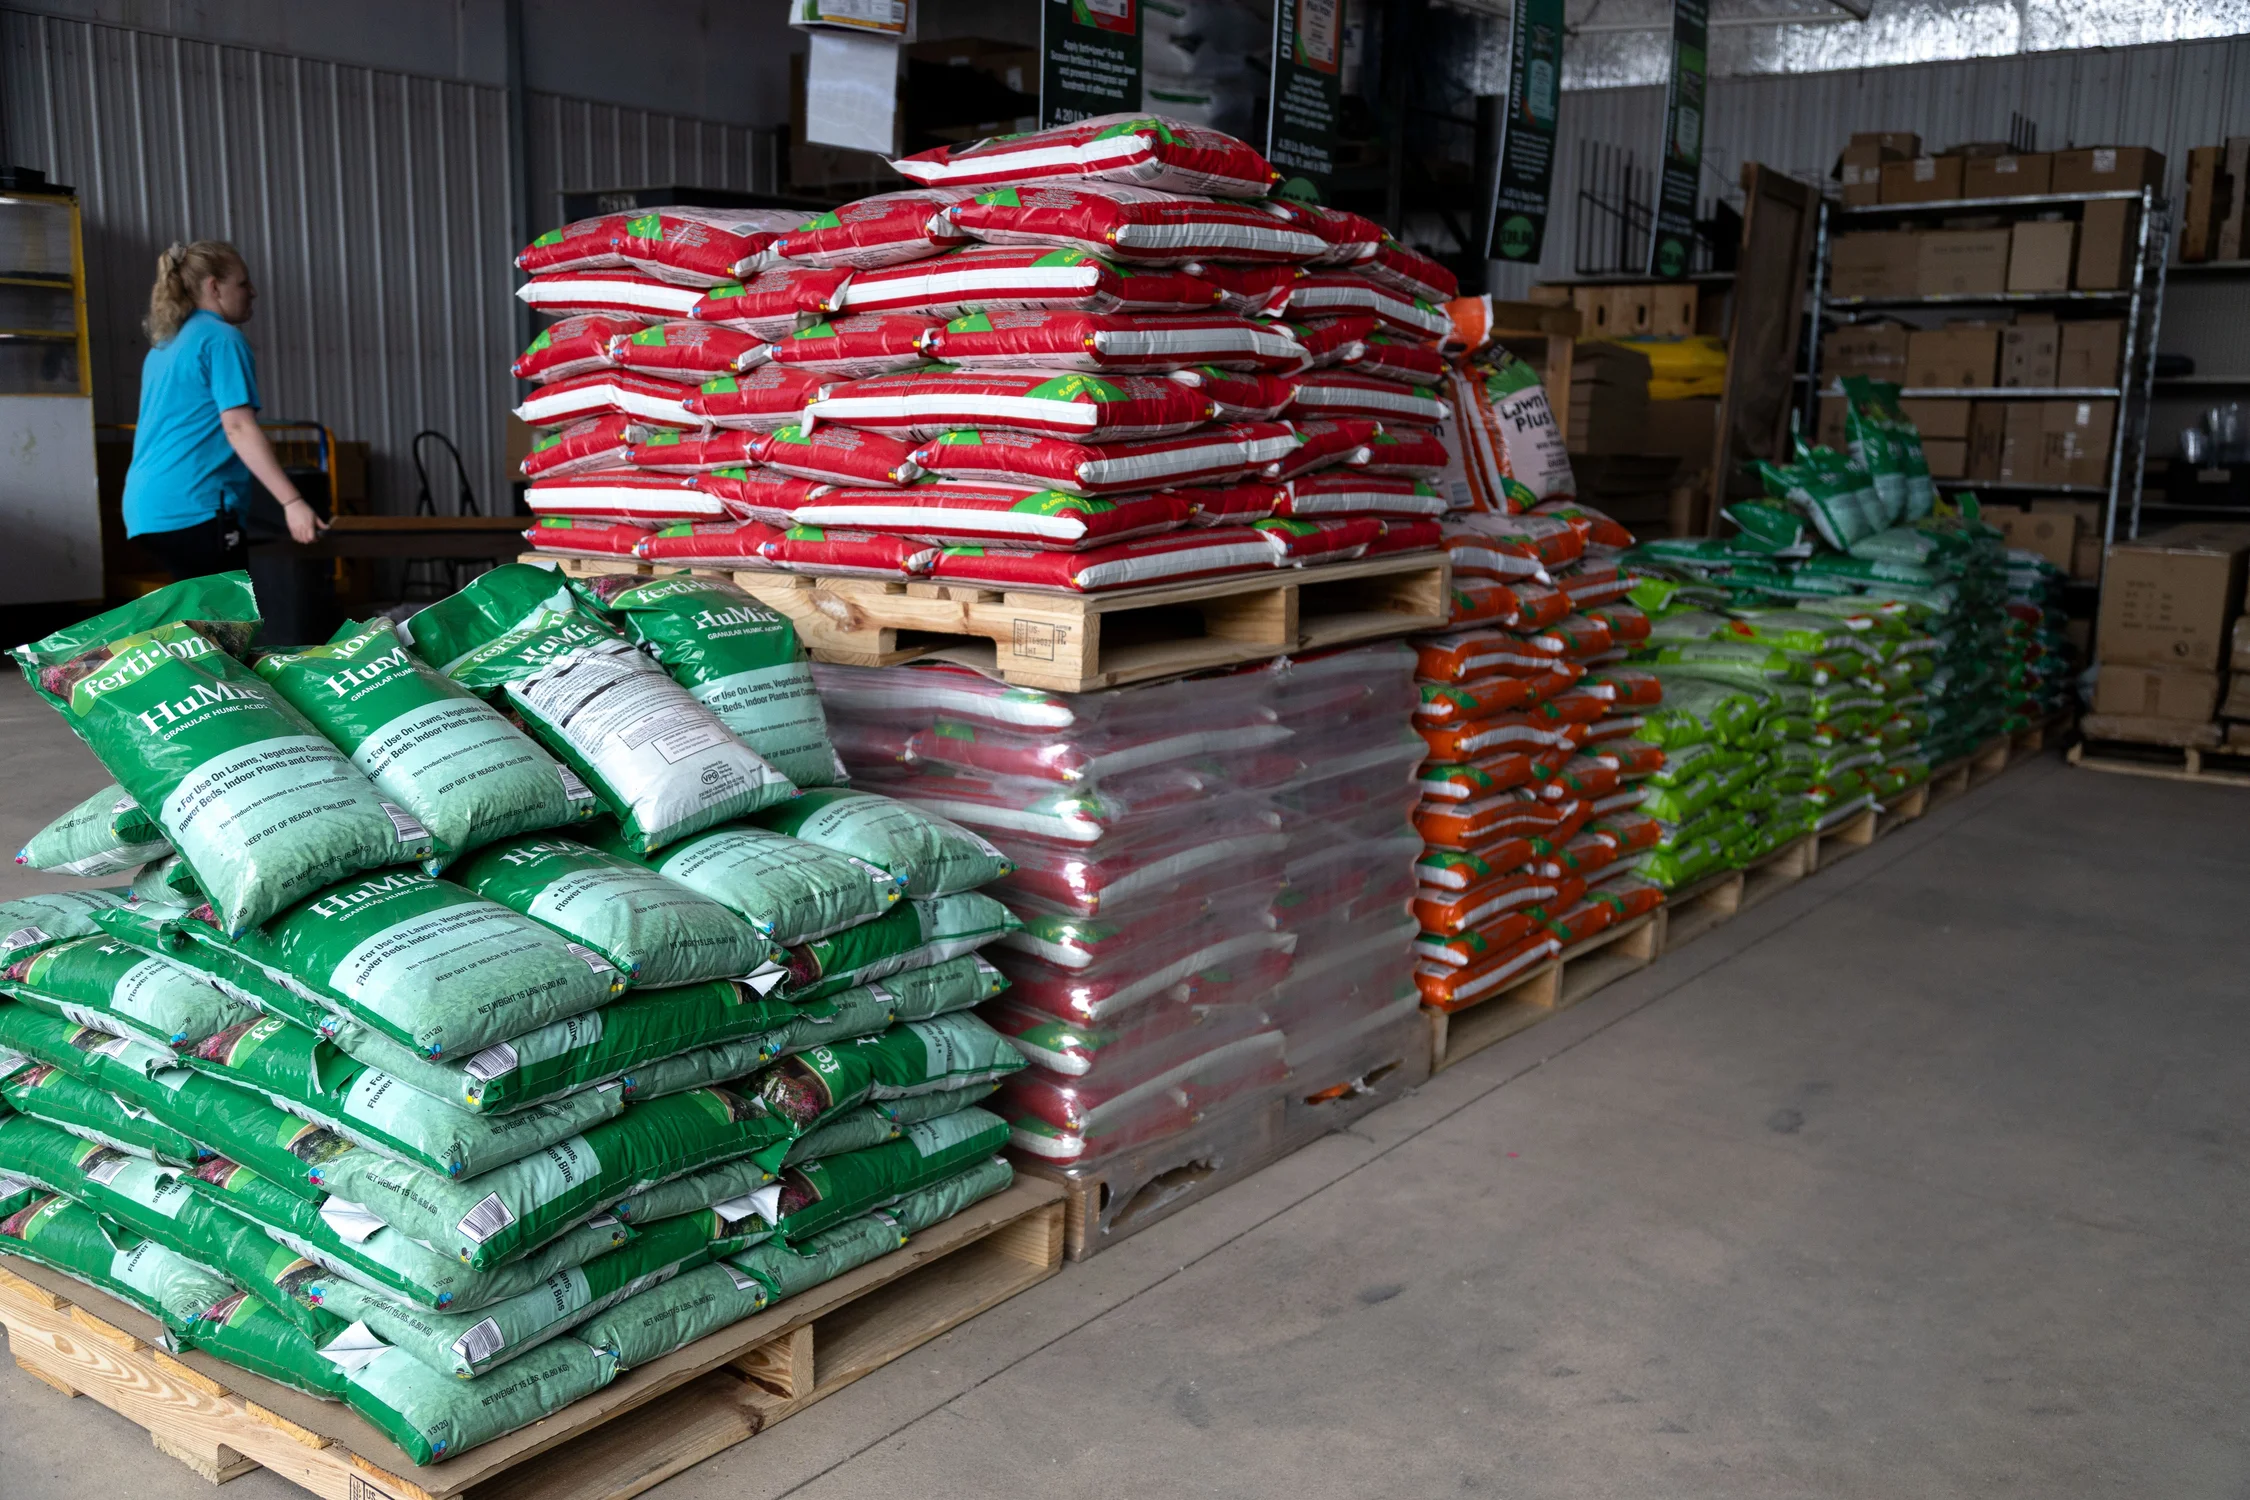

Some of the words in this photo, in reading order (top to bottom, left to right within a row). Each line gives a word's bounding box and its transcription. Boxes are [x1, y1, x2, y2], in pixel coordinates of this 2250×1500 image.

[1280, 0, 1294, 60] DEEP
[1515, 0, 1528, 69] LASTIN
[1510, 72, 1523, 120] LONG
[1515, 411, 1550, 433] Plus
[691, 606, 780, 630] HuMic
[707, 629, 743, 640] GRANULAR
[323, 646, 409, 699] HuM
[350, 675, 393, 702] GRANULAR
[721, 689, 737, 700] Use
[736, 686, 748, 696] On
[748, 681, 774, 693] Lawns,
[772, 677, 801, 688] Vegetable
[722, 700, 746, 714] Beds,
[745, 695, 768, 707] Indoor
[768, 690, 789, 701] Plants
[789, 690, 801, 698] and
[136, 681, 265, 736] HuMic
[163, 713, 212, 741] GRANULAR
[212, 704, 243, 717] HUMIC
[370, 744, 385, 759] For
[384, 732, 402, 748] Use
[401, 725, 415, 737] On
[414, 713, 446, 730] Lawns,
[442, 706, 480, 718] Vegetable
[367, 756, 392, 783] Flower
[391, 740, 417, 759] Beds,
[415, 725, 443, 745] Indoor
[443, 717, 469, 730] Plants
[469, 715, 484, 724] and
[412, 768, 424, 779] This
[422, 757, 443, 771] Product
[441, 752, 452, 761] Not
[450, 744, 473, 757] Intended
[180, 792, 197, 809] For
[193, 779, 212, 794] Use
[211, 769, 226, 782] On
[225, 755, 263, 774] Lawns,
[259, 745, 309, 761] Vegetable
[437, 782, 455, 795] KEEP
[454, 776, 468, 787] OUT
[467, 771, 478, 780] OF
[476, 764, 499, 778] REACH
[498, 761, 507, 770] OF
[505, 755, 534, 767] CHILDREN
[703, 771, 718, 782] VPG
[178, 806, 201, 834] Flower
[199, 787, 226, 808] Beds,
[225, 770, 256, 790] Indoor
[256, 759, 288, 775] Plants
[288, 756, 306, 766] and
[218, 819, 232, 831] This
[230, 806, 253, 822] Product
[251, 800, 263, 809] Not
[262, 788, 288, 803] Intended
[298, 779, 323, 790] Fertilizer
[243, 832, 262, 848] KEEP
[262, 825, 278, 837] OUT
[278, 818, 289, 829] OF
[288, 810, 313, 826] REACH
[312, 805, 323, 815] OF
[322, 797, 357, 811] CHILDREN
[821, 818, 842, 837] Flower
[822, 813, 834, 824] For
[681, 859, 705, 878] Flower
[684, 852, 698, 864] For
[281, 877, 296, 889] NET
[320, 861, 329, 870] 15
[557, 882, 572, 894] For
[307, 873, 434, 920] HuMic
[339, 899, 383, 922] GRANULAR
[385, 889, 414, 901] HUMIC
[414, 883, 439, 891] ACIDS
[554, 890, 581, 912] Flower
[359, 949, 376, 964] For
[374, 938, 395, 951] Use
[393, 931, 409, 941] On
[409, 919, 443, 935] Lawns,
[441, 908, 482, 923] Vegetable
[355, 958, 383, 986] Flower
[382, 943, 411, 959] Beds,
[409, 931, 439, 946] Indoor
[438, 920, 468, 933] Plants
[468, 916, 485, 925] and
[405, 962, 418, 971] This
[416, 953, 439, 966] Product
[438, 949, 449, 958] Not
[448, 941, 473, 955] Intended
[435, 969, 453, 982] KEEP
[453, 964, 468, 975] OUT
[467, 960, 479, 970] OF
[477, 952, 502, 966] REACH
[501, 950, 510, 959] OF
[509, 941, 543, 956] CHILDREN
[626, 948, 645, 958] 13120
[127, 976, 150, 1002] Flower
[130, 970, 146, 982] For
[477, 1002, 492, 1015] NET
[491, 992, 517, 1010] WEIGHT
[516, 989, 526, 1000] 15
[525, 985, 539, 997] LBS.
[539, 979, 556, 993] (6.80
[555, 977, 568, 988] KG)
[420, 1025, 443, 1043] 13120
[370, 1071, 386, 1086] For
[367, 1079, 393, 1109] Flower
[490, 1125, 503, 1135] NET
[502, 1116, 527, 1132] WEIGHT
[527, 1114, 536, 1123] 15
[562, 1101, 575, 1111] KG)
[441, 1141, 461, 1160] 13120
[559, 1162, 574, 1184] Bins
[365, 1171, 378, 1182] NET
[377, 1174, 401, 1193] WEIGHT
[400, 1187, 411, 1197] 15
[427, 1203, 439, 1216] KG)
[127, 1245, 149, 1273] Flower
[432, 1276, 453, 1289] 13120
[180, 1299, 199, 1314] 13120
[553, 1288, 565, 1312] Bins
[643, 1317, 653, 1328] NET
[653, 1307, 673, 1324] WEIGHT
[680, 1302, 692, 1313] LBS.
[693, 1298, 706, 1310] (6.80
[704, 1293, 716, 1304] KG)
[409, 1317, 423, 1332] (6.80
[422, 1324, 433, 1337] KG)
[482, 1393, 494, 1407] NET
[493, 1383, 519, 1401] WEIGHT
[518, 1379, 526, 1389] 15
[526, 1374, 541, 1387] LBS.
[542, 1368, 557, 1382] (6.80
[556, 1362, 570, 1376] KG)
[427, 1419, 449, 1437] 13120
